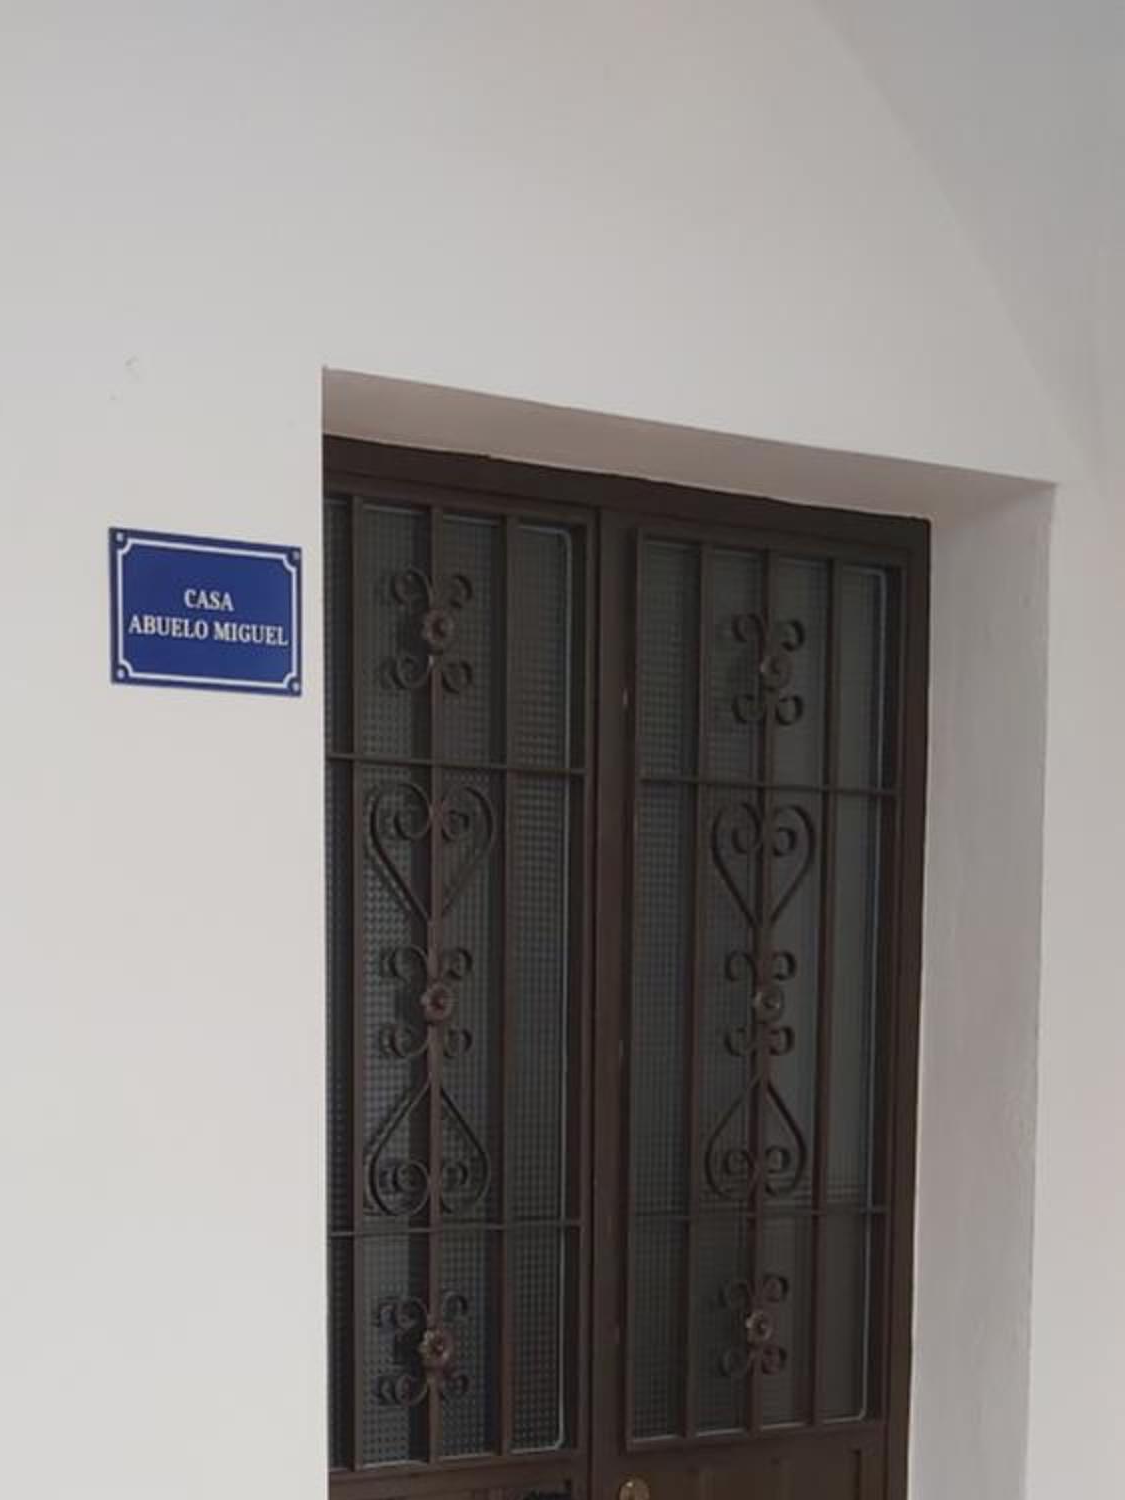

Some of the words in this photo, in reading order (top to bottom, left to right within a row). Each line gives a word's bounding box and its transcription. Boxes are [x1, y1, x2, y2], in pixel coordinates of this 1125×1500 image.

[184, 589, 234, 611] CASA
[128, 615, 208, 640] ABUELO
[213, 621, 289, 646] MIGUEL
